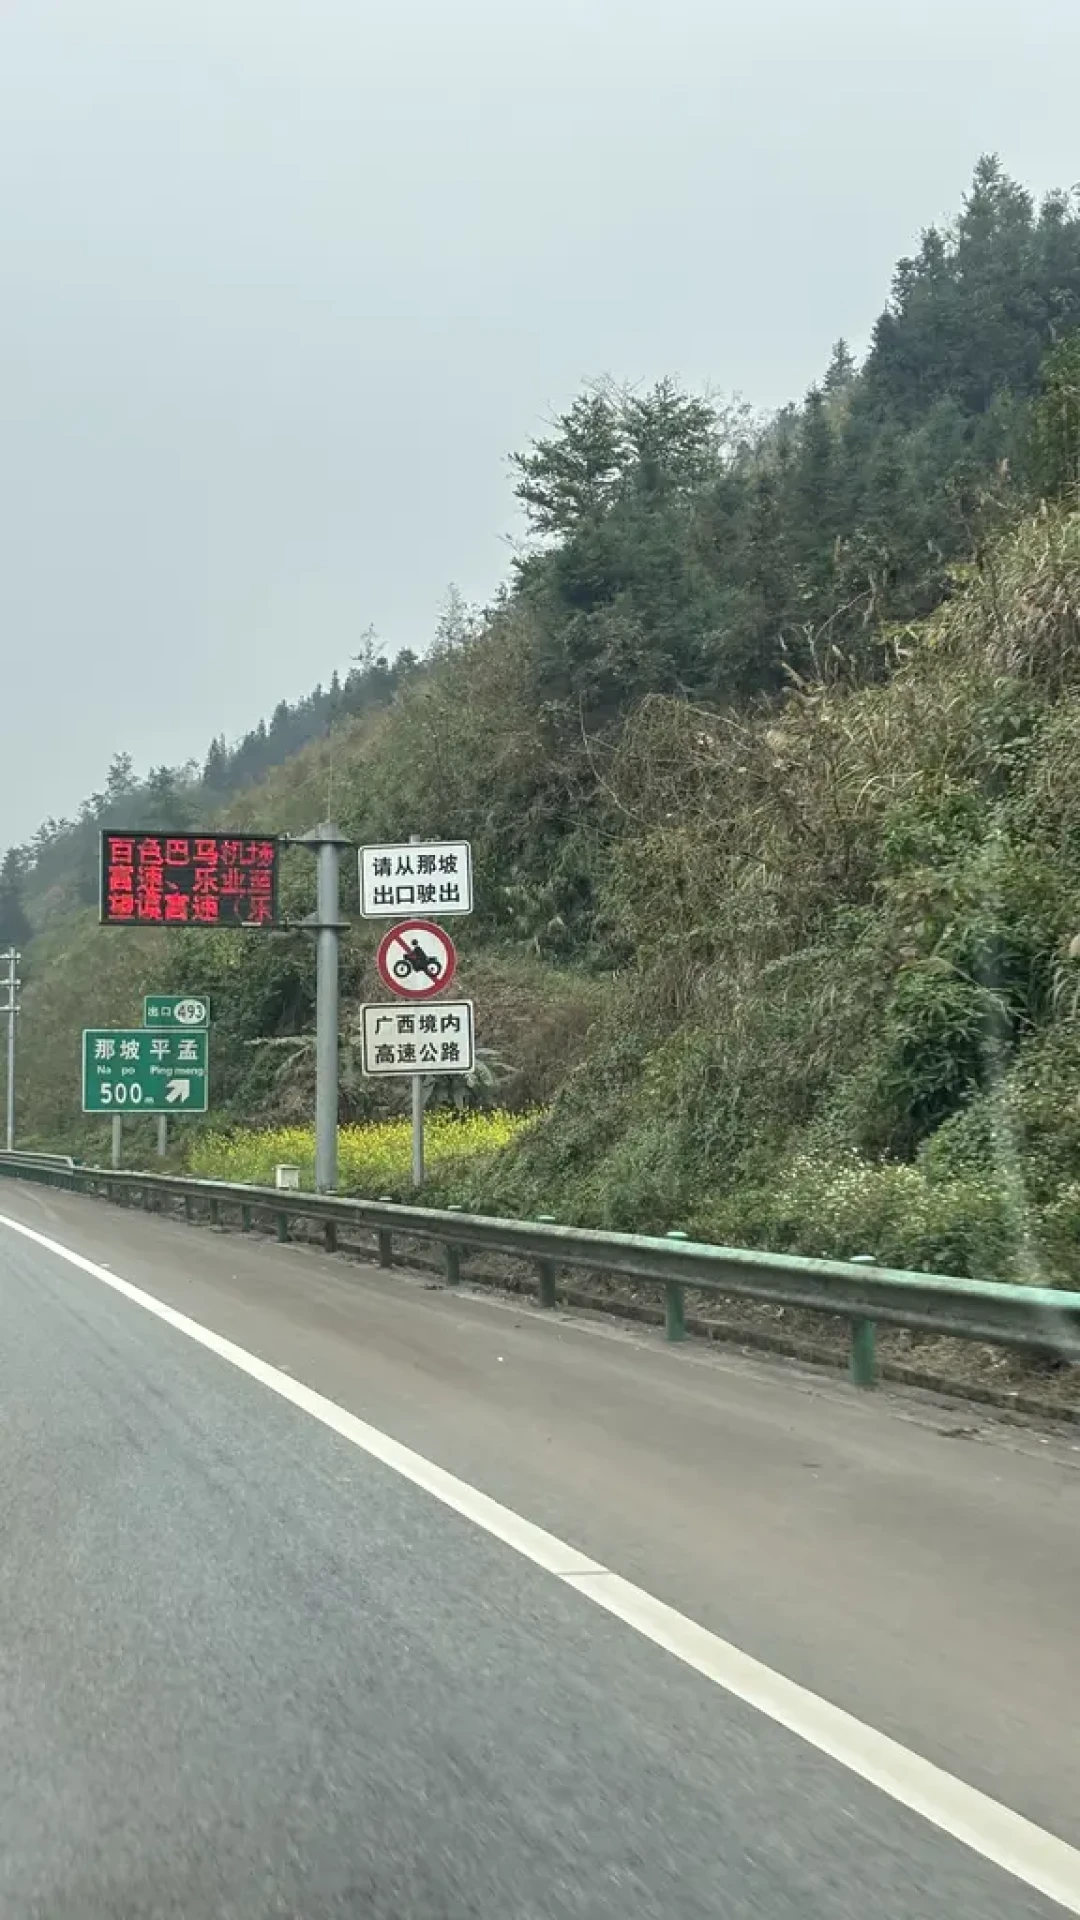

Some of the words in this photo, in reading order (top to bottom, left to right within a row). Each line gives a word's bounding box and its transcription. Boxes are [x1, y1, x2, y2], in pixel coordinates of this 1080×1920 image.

[108, 837, 275, 867] 百色巴马机场
[372, 852, 459, 877] 请从那坡
[373, 881, 460, 905] 出口驶出
[147, 1005, 172, 1017] 出口
[177, 1004, 204, 1019] 493
[374, 1013, 460, 1035] 广西境内
[94, 1038, 140, 1060] 那坡
[149, 1038, 199, 1061] 平孟
[374, 1041, 461, 1064] 高速公路
